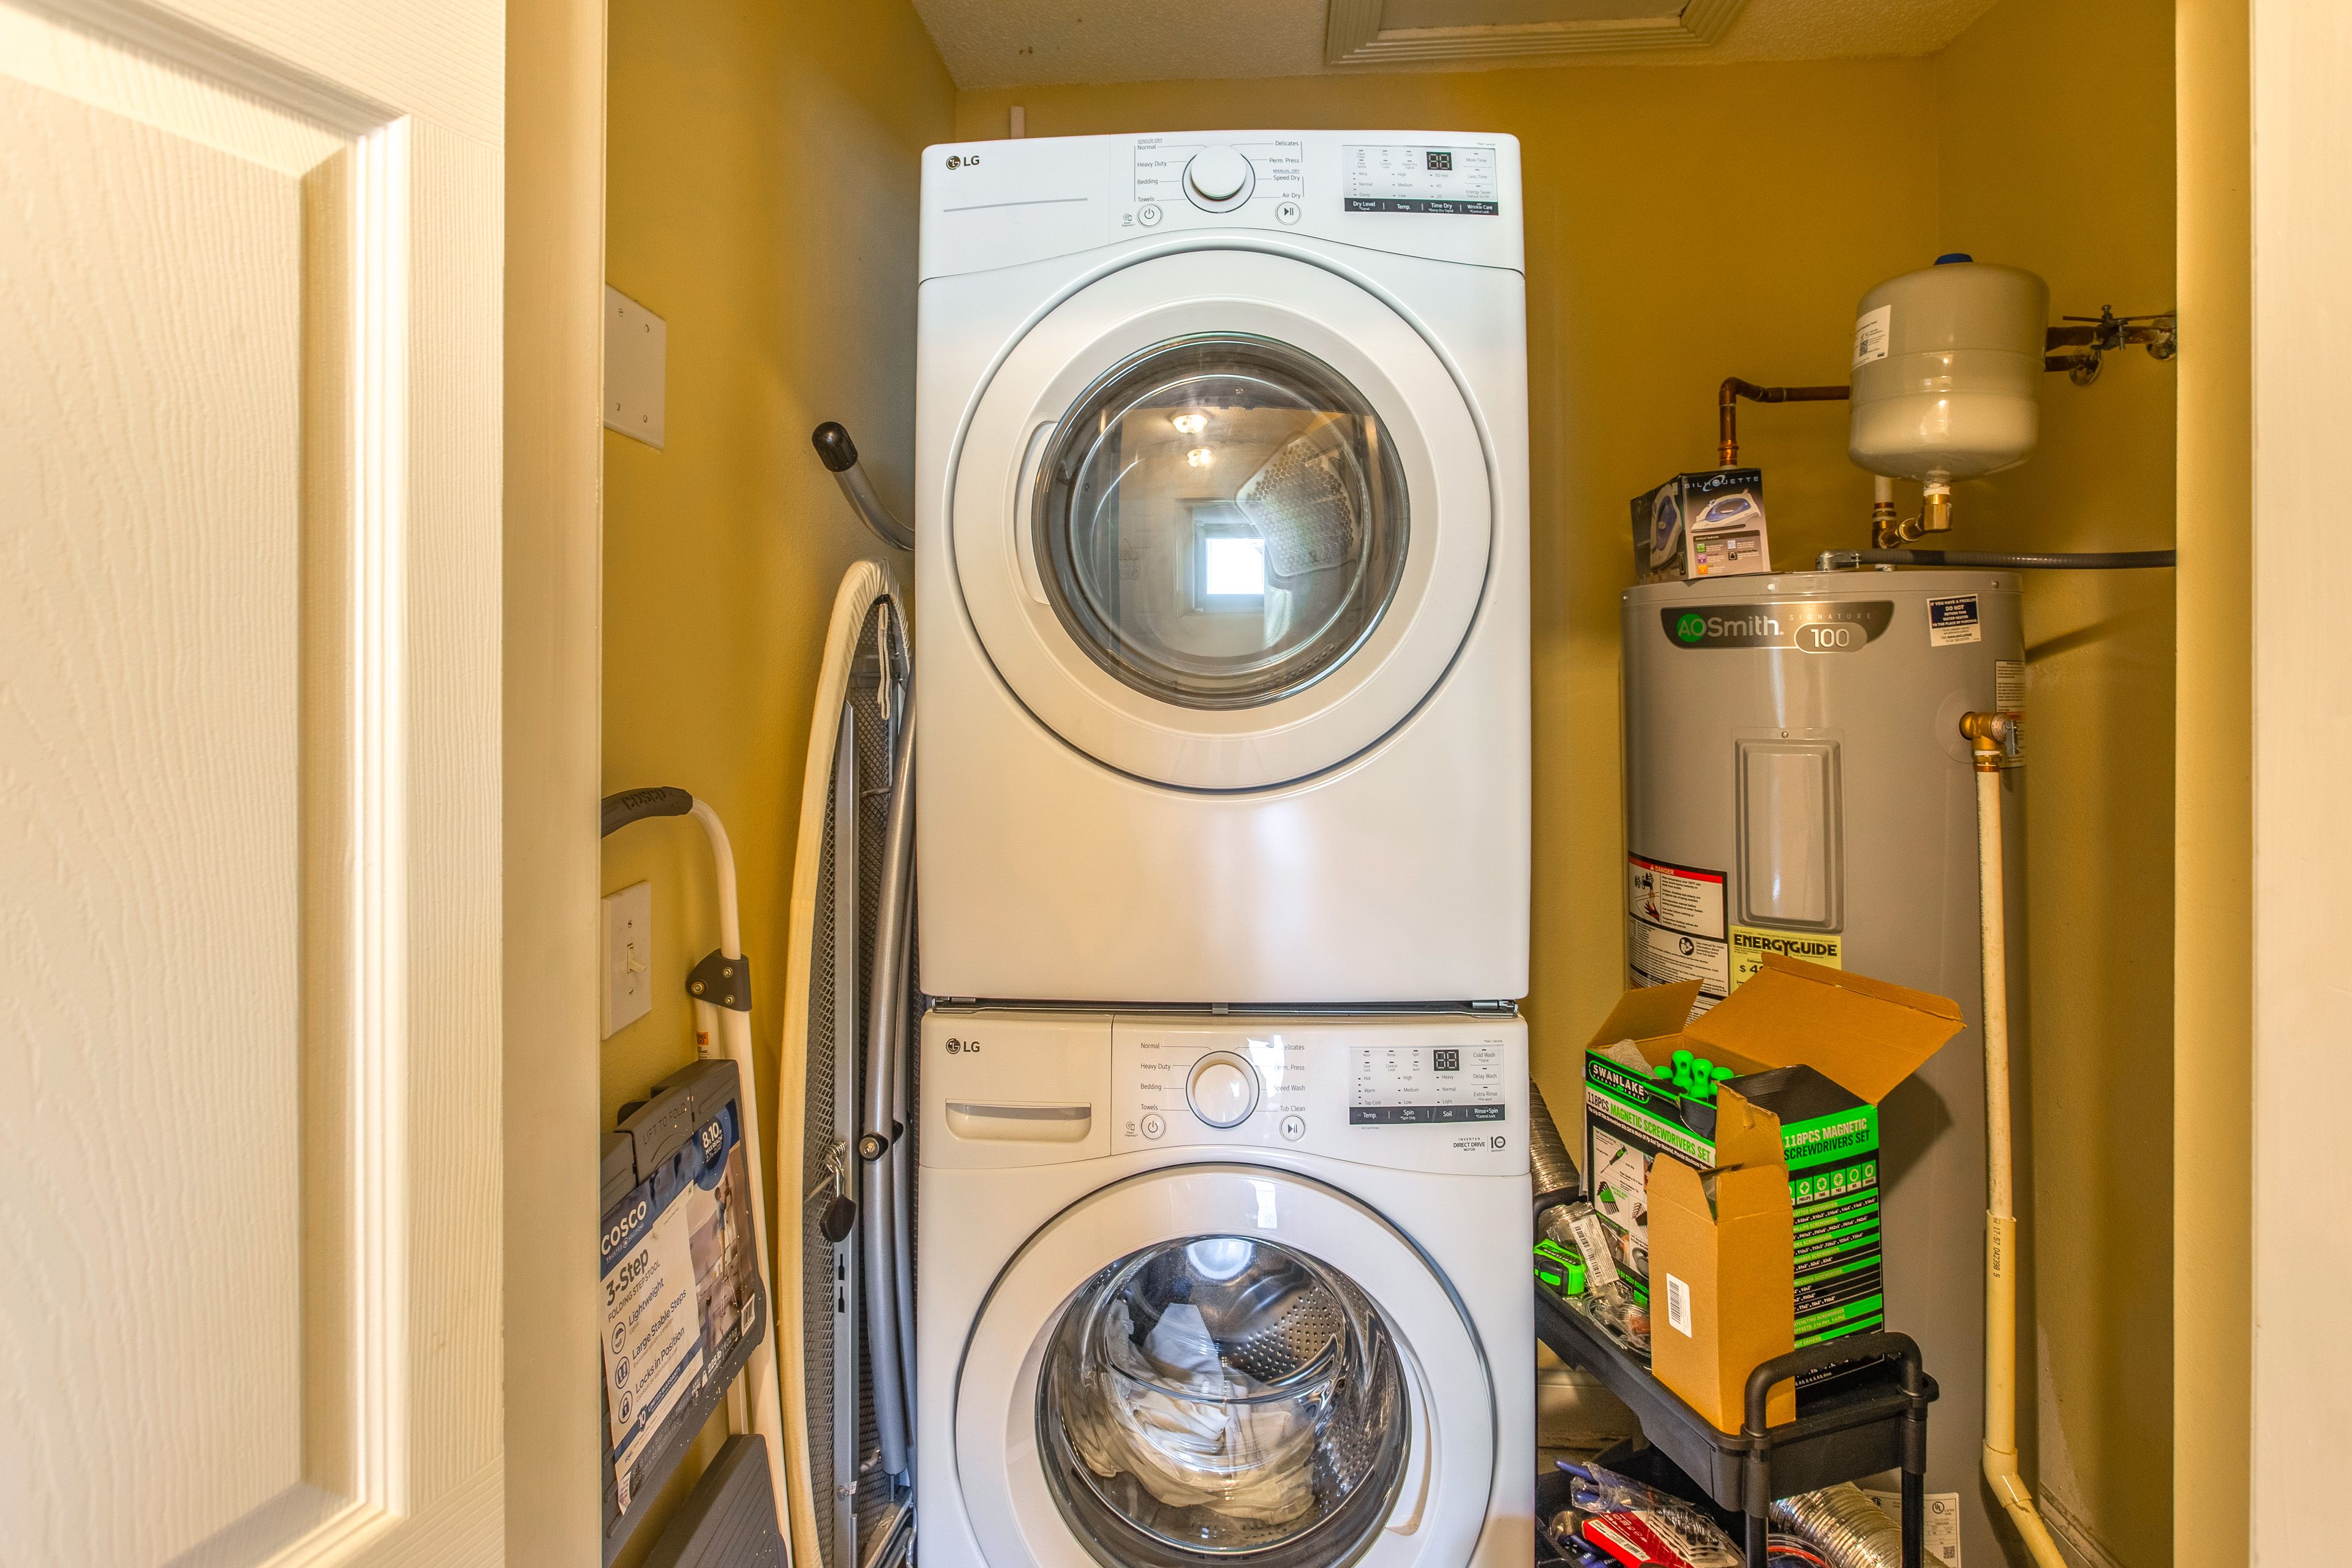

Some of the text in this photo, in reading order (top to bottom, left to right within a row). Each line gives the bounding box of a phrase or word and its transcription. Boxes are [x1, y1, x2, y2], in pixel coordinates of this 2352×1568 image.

[963, 156, 980, 166] LG
[1684, 477, 1759, 489] SILHOUETTE
[1811, 628, 1850, 647] 100
[621, 788, 666, 810] COSCO
[1655, 866, 1675, 875] DANGER
[1734, 933, 1838, 957] ENERGYGUIDE
[963, 1041, 980, 1052] LG
[1593, 1064, 1644, 1096] SWANLAKE
[643, 1103, 685, 1145] LIFT TO FOLD
[1588, 1092, 1710, 1163] 118PCS MAGNETIC SCREWDRIVERS SET
[1784, 1118, 1867, 1148] 118PCS MAGNETIC
[1490, 1136, 1506, 1148] 10
[1784, 1129, 1870, 1161] SCREWDRIVERS SET
[601, 1201, 647, 1255] COSCO
[606, 1249, 649, 1306] 3-Step
[608, 1260, 661, 1323] FOLDING STEP STOOL
[628, 1278, 665, 1326] Lightweight
[632, 1333, 651, 1360] Large
[651, 1310, 670, 1336] Stable
[670, 1289, 687, 1313] Steps
[636, 1366, 654, 1394] Locks
[654, 1357, 660, 1370] in
[661, 1327, 685, 1361] Position
[638, 1409, 646, 1428] 10
[648, 1389, 662, 1412] LIMITED
[662, 1366, 681, 1393] WARRANTY
